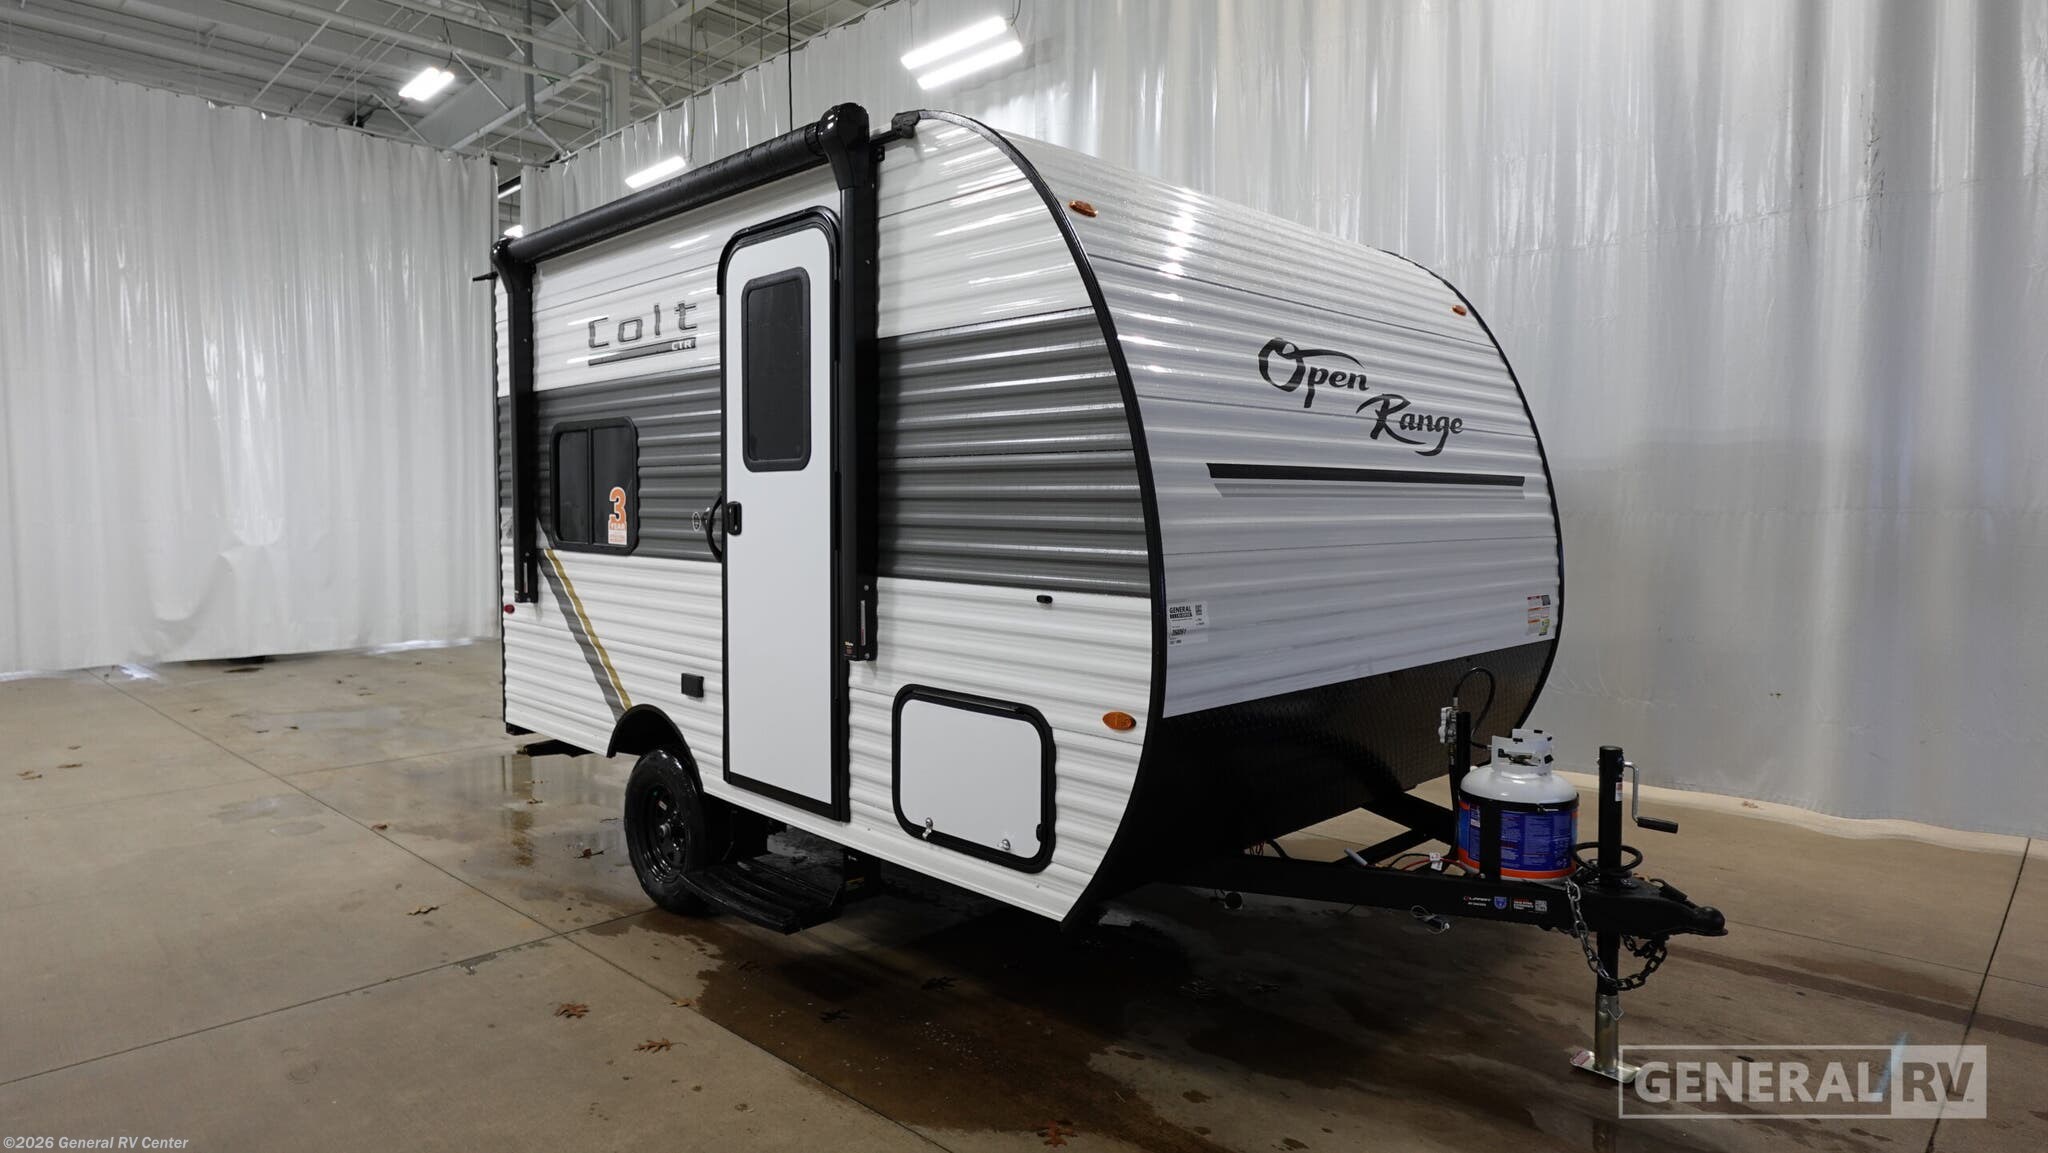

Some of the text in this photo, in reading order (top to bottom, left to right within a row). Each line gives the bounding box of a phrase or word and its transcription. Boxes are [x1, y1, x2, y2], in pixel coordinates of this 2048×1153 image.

[588, 302, 697, 349] Colt
[671, 340, 692, 351] CTR
[1258, 337, 1369, 408] Open
[1356, 393, 1463, 456] Range
[609, 487, 626, 524] 3
[1169, 605, 1191, 614] GENERAL
